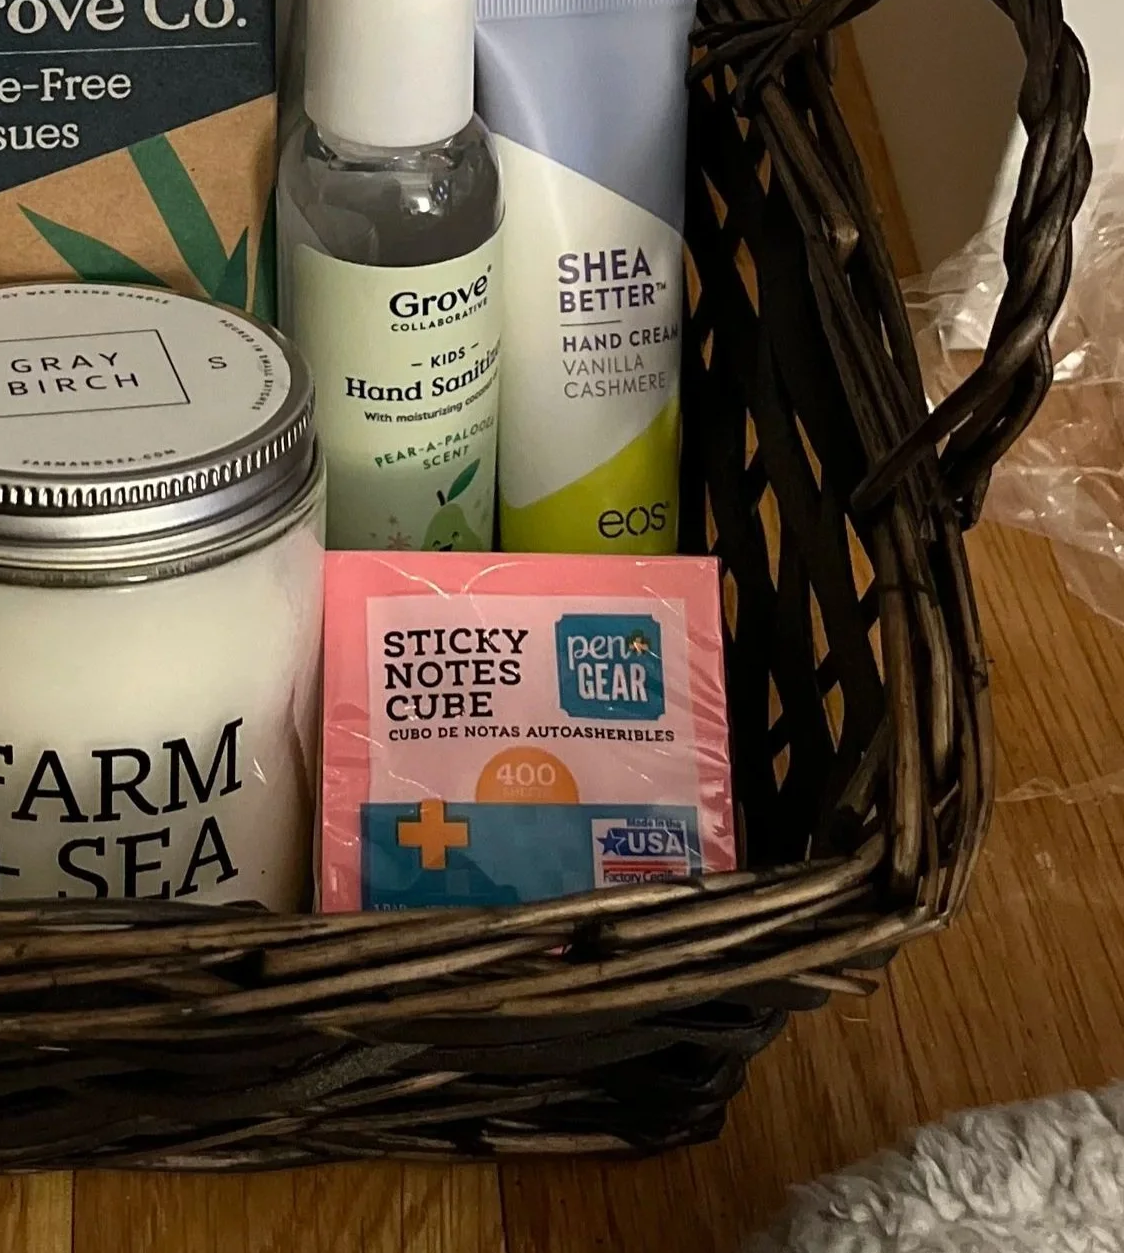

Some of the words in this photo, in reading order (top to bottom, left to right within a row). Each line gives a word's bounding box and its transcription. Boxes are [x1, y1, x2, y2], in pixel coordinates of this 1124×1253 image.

[557, 246, 652, 285] SHEA
[64, 288, 111, 296] BLEND
[117, 291, 171, 305] CANDLE
[388, 274, 488, 319] Grove
[390, 296, 488, 333] COLLABORATIVE
[219, 319, 255, 343] POURED
[562, 333, 622, 353] HAND
[10, 352, 118, 374] GRAY
[207, 356, 227, 369] S
[258, 354, 274, 377] SMALL
[430, 346, 466, 369] KIDS
[562, 353, 645, 376] VANILLA
[7, 373, 139, 396] BIRCH
[251, 379, 274, 410] BATCHES
[345, 376, 423, 403] Hand
[563, 371, 668, 399] CASHMERE
[363, 411, 393, 423] With
[396, 402, 464, 423] moisturizing
[21, 448, 176, 467] FARMANDSEA.COM
[422, 445, 470, 470] SCENT
[598, 502, 666, 539] eos
[383, 627, 529, 658] STICKY
[567, 633, 632, 670] pen
[384, 659, 522, 690] NOTES
[577, 662, 649, 702] GEAR
[385, 691, 494, 721] CUBE
[388, 727, 433, 741] CUBO
[438, 726, 459, 739] DE
[464, 725, 521, 739] NOTAS
[526, 725, 675, 742] AUTOASHERIBLES
[496, 762, 556, 786] 400
[627, 831, 684, 854] USA
[57, 815, 239, 899] SEA
[603, 870, 642, 884] Factory
